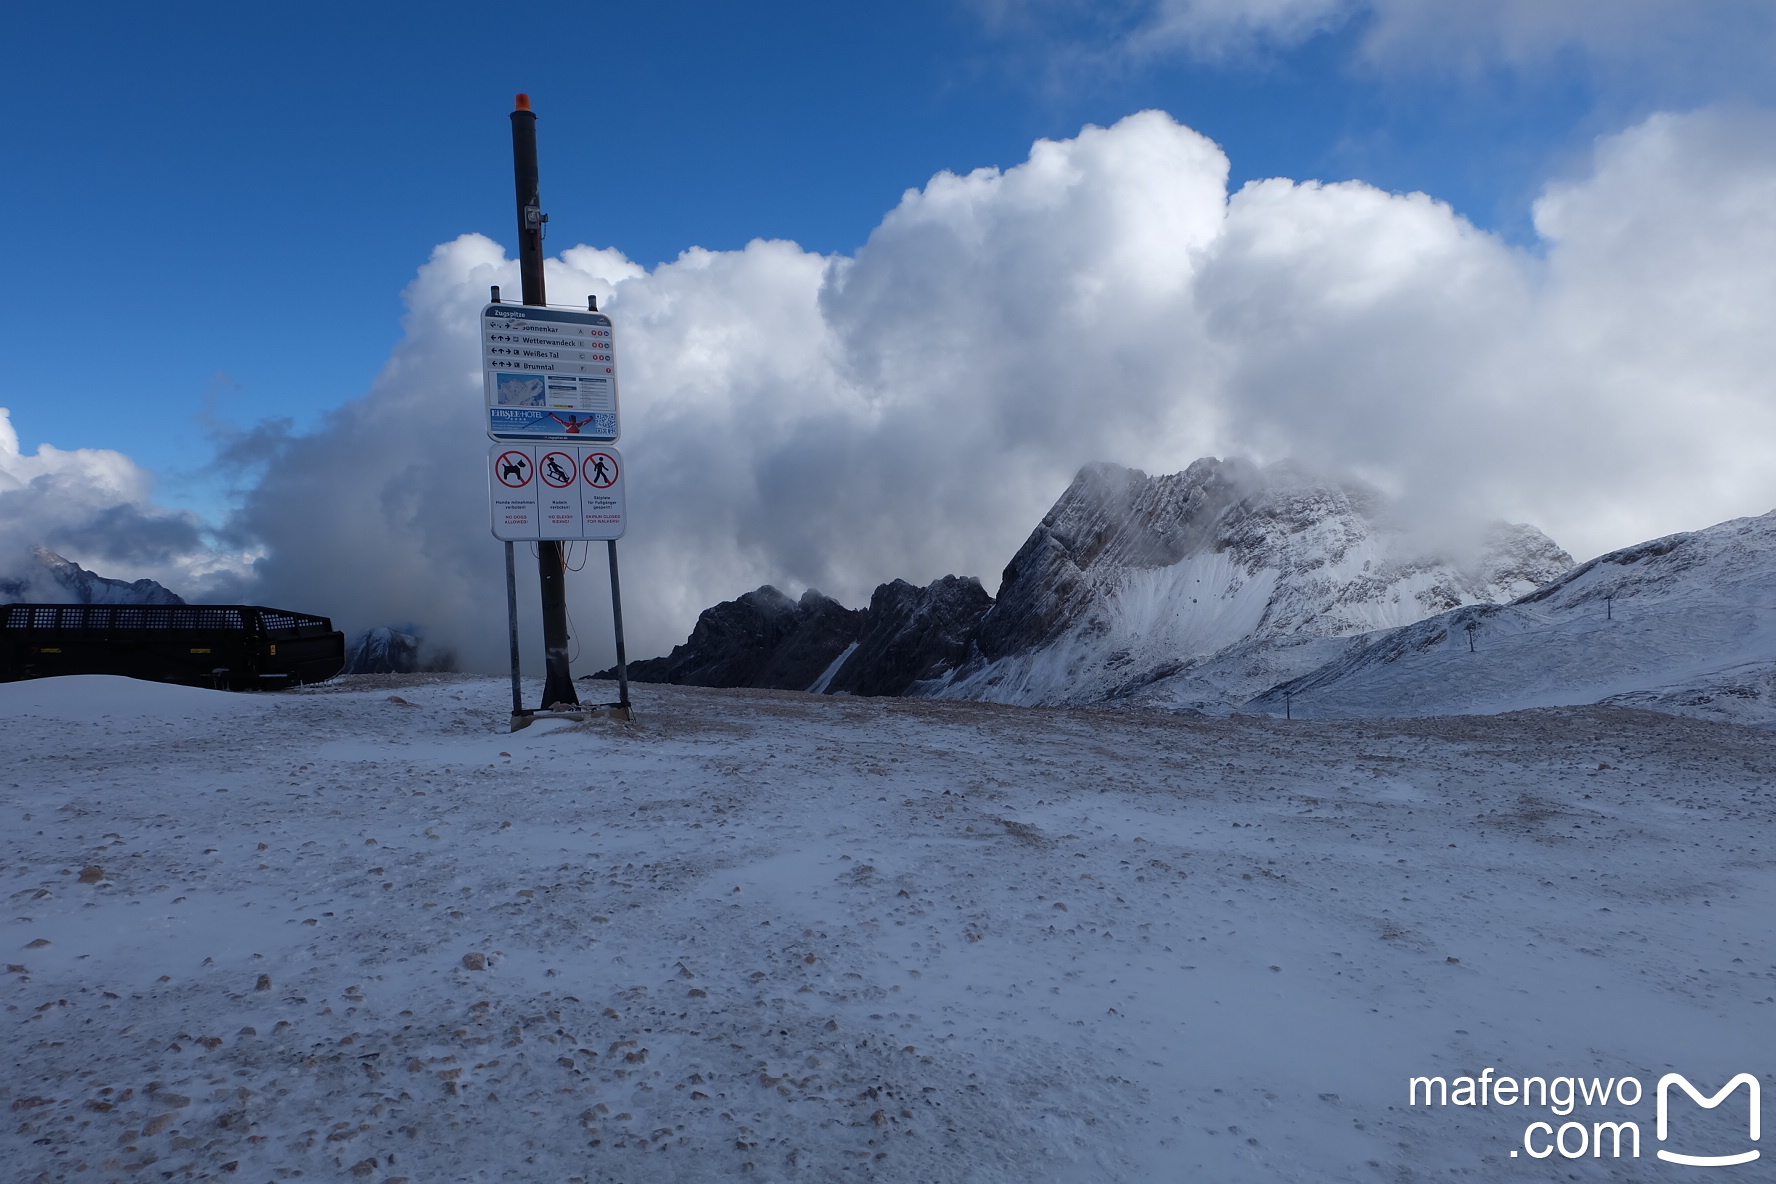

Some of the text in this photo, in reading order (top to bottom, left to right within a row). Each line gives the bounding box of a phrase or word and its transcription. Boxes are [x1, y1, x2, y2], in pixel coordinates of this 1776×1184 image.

[494, 309, 526, 318] Zugspitze
[522, 336, 576, 346] Wetterwandeck
[523, 349, 548, 358] Weißes
[523, 362, 555, 371] Brunntal
